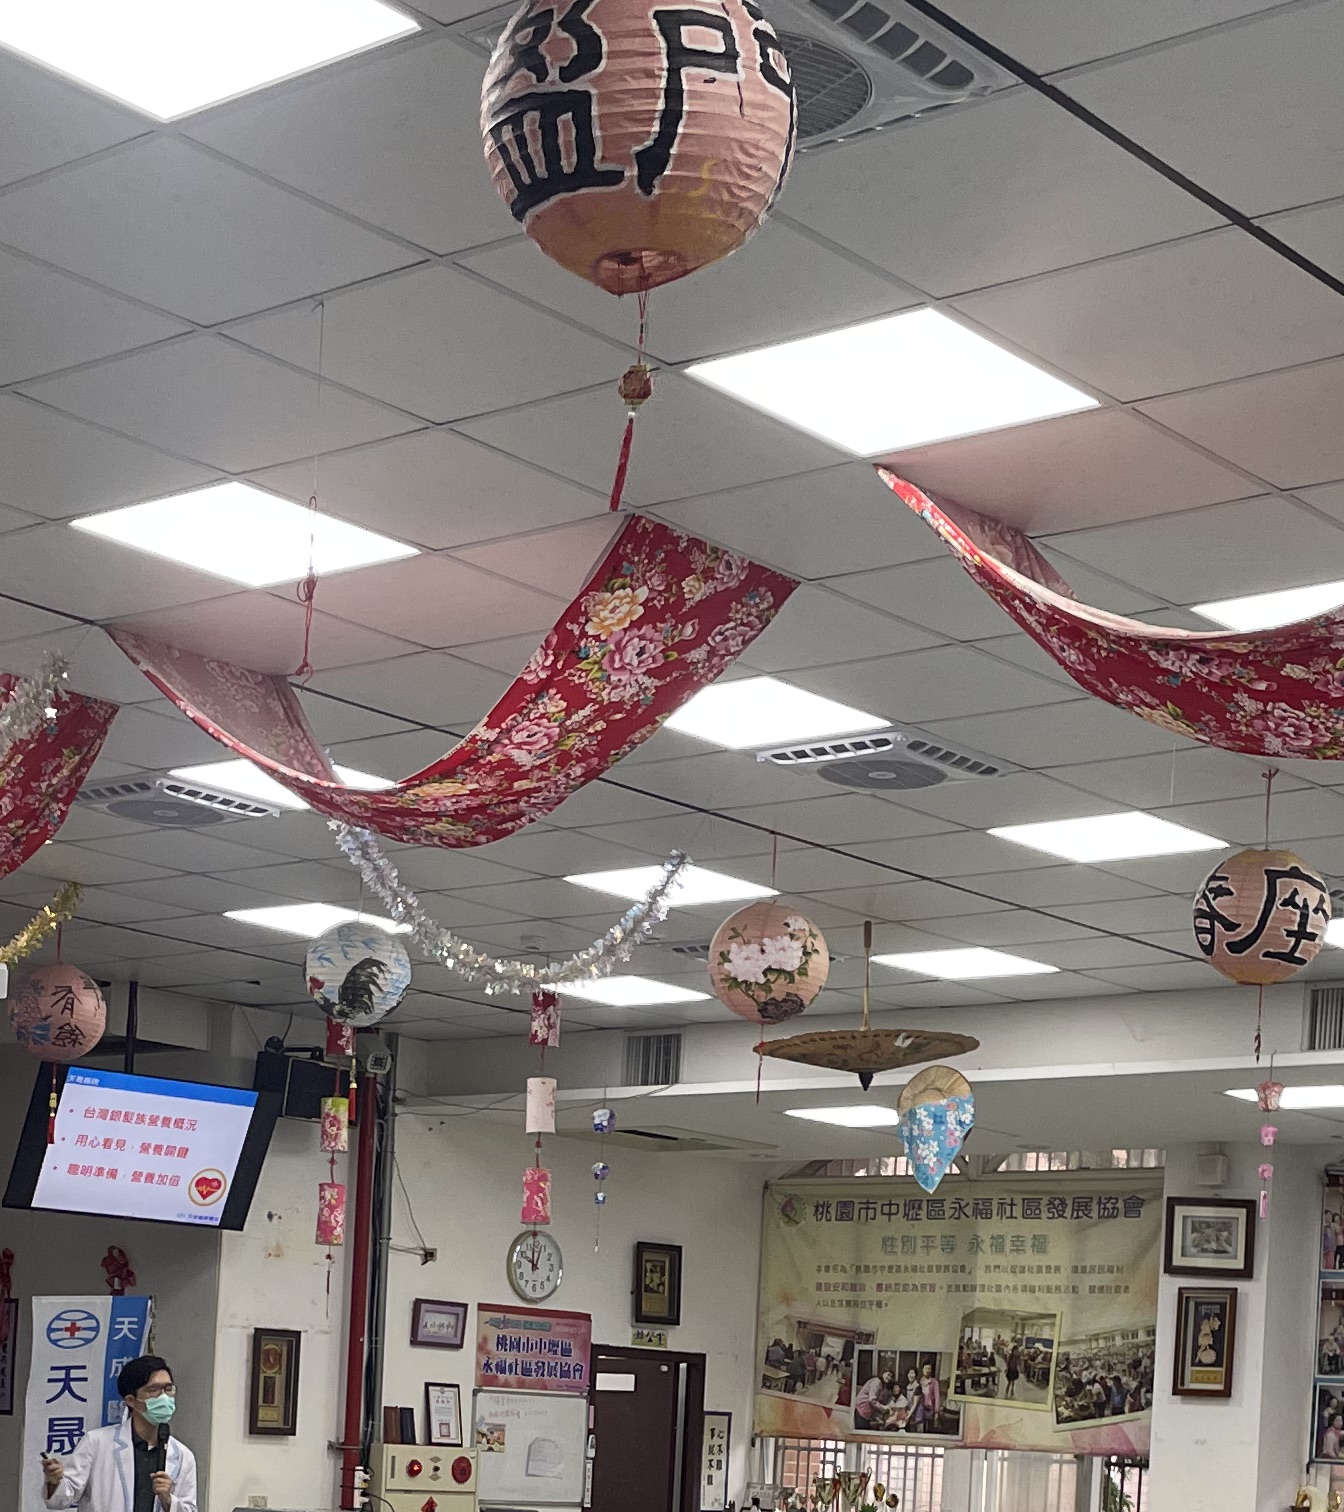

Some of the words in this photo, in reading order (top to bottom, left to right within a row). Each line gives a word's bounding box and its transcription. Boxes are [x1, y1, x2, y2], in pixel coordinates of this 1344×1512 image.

[812, 1195, 1146, 1223] 桃園市中壢區永福社區發展協會
[880, 1234, 957, 1256] 性別平等
[968, 1233, 1050, 1255] 永福幸福
[496, 1333, 573, 1358] 桃園市中壢區
[483, 1356, 584, 1381] 永福社區發展協會
